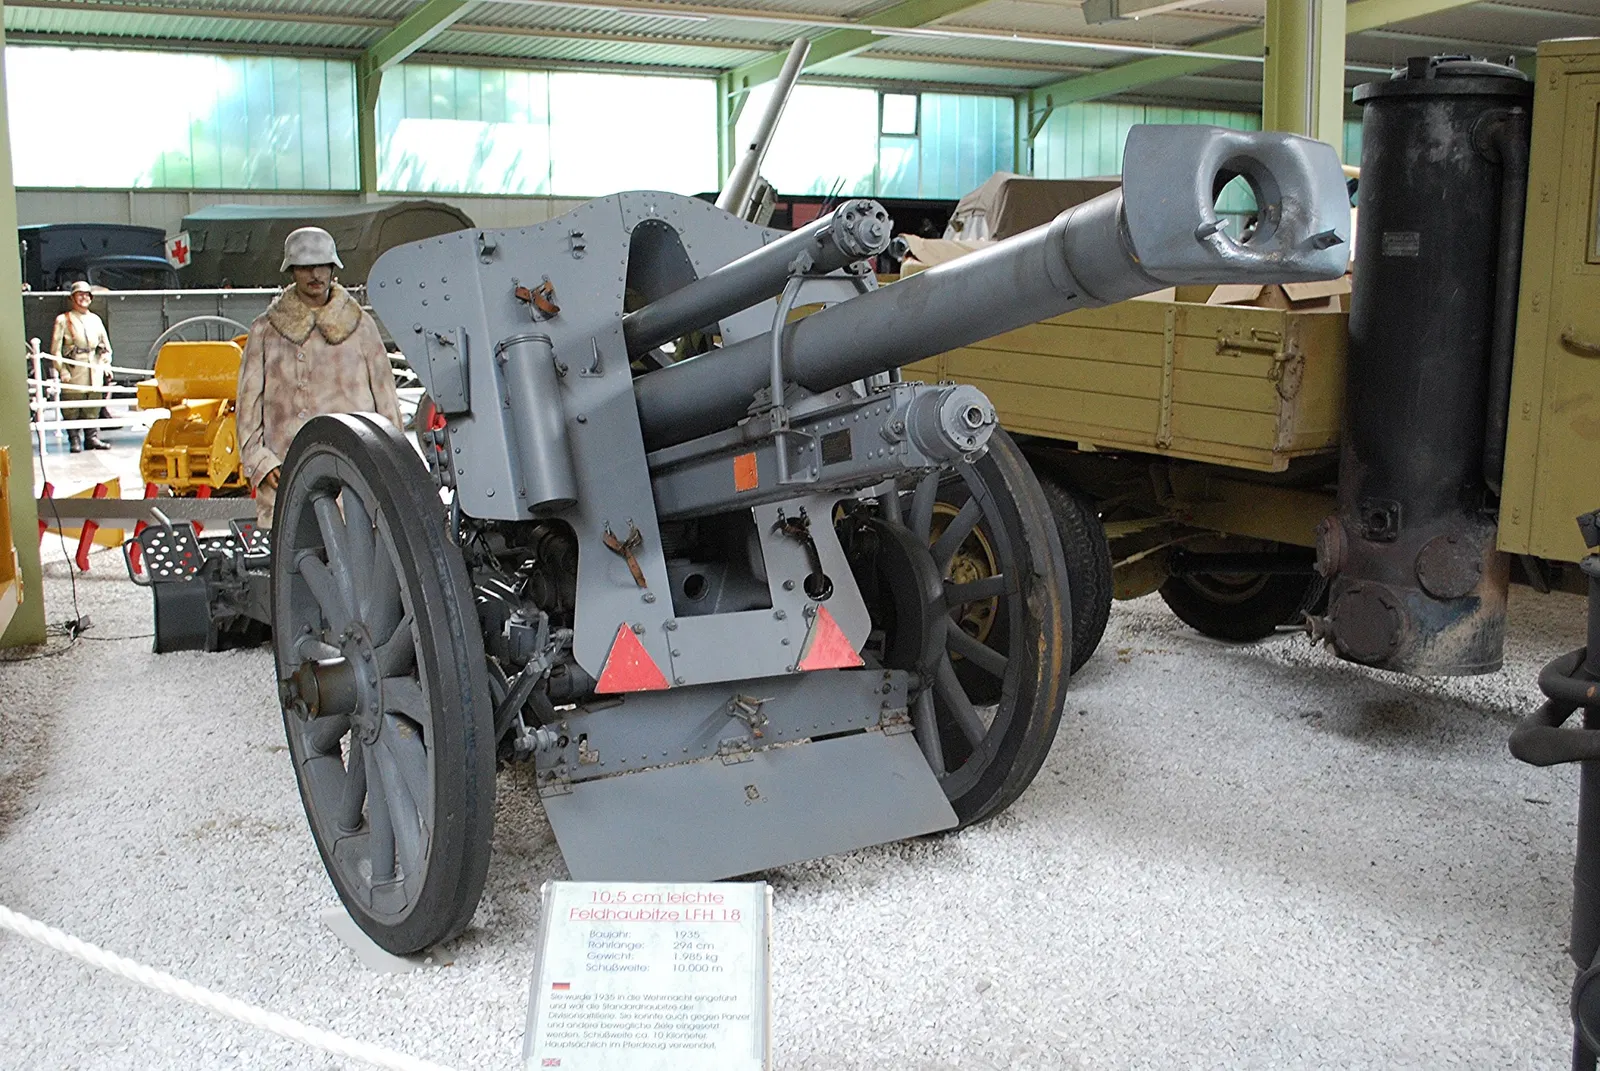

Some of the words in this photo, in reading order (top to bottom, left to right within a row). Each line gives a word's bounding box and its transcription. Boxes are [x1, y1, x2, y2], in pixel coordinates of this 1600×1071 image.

[592, 891, 627, 903] 10,5
[632, 893, 662, 903] cm
[667, 892, 724, 903] leichte
[569, 908, 680, 920] Feldhaubitze
[685, 908, 713, 920] LFH
[721, 909, 741, 920] 18
[589, 930, 631, 940] Baujahr:
[674, 931, 700, 939] 1935
[673, 942, 693, 950] 294
[587, 952, 633, 960] Gewicht:
[673, 953, 702, 961] 1.985
[705, 953, 718, 962] kg
[585, 963, 650, 972] Schußweite:
[672, 964, 708, 972] 10.000
[665, 1012, 688, 1020] auch
[690, 1012, 719, 1021] gegen
[722, 1012, 750, 1020] Panzer
[653, 1031, 663, 1039] 10
